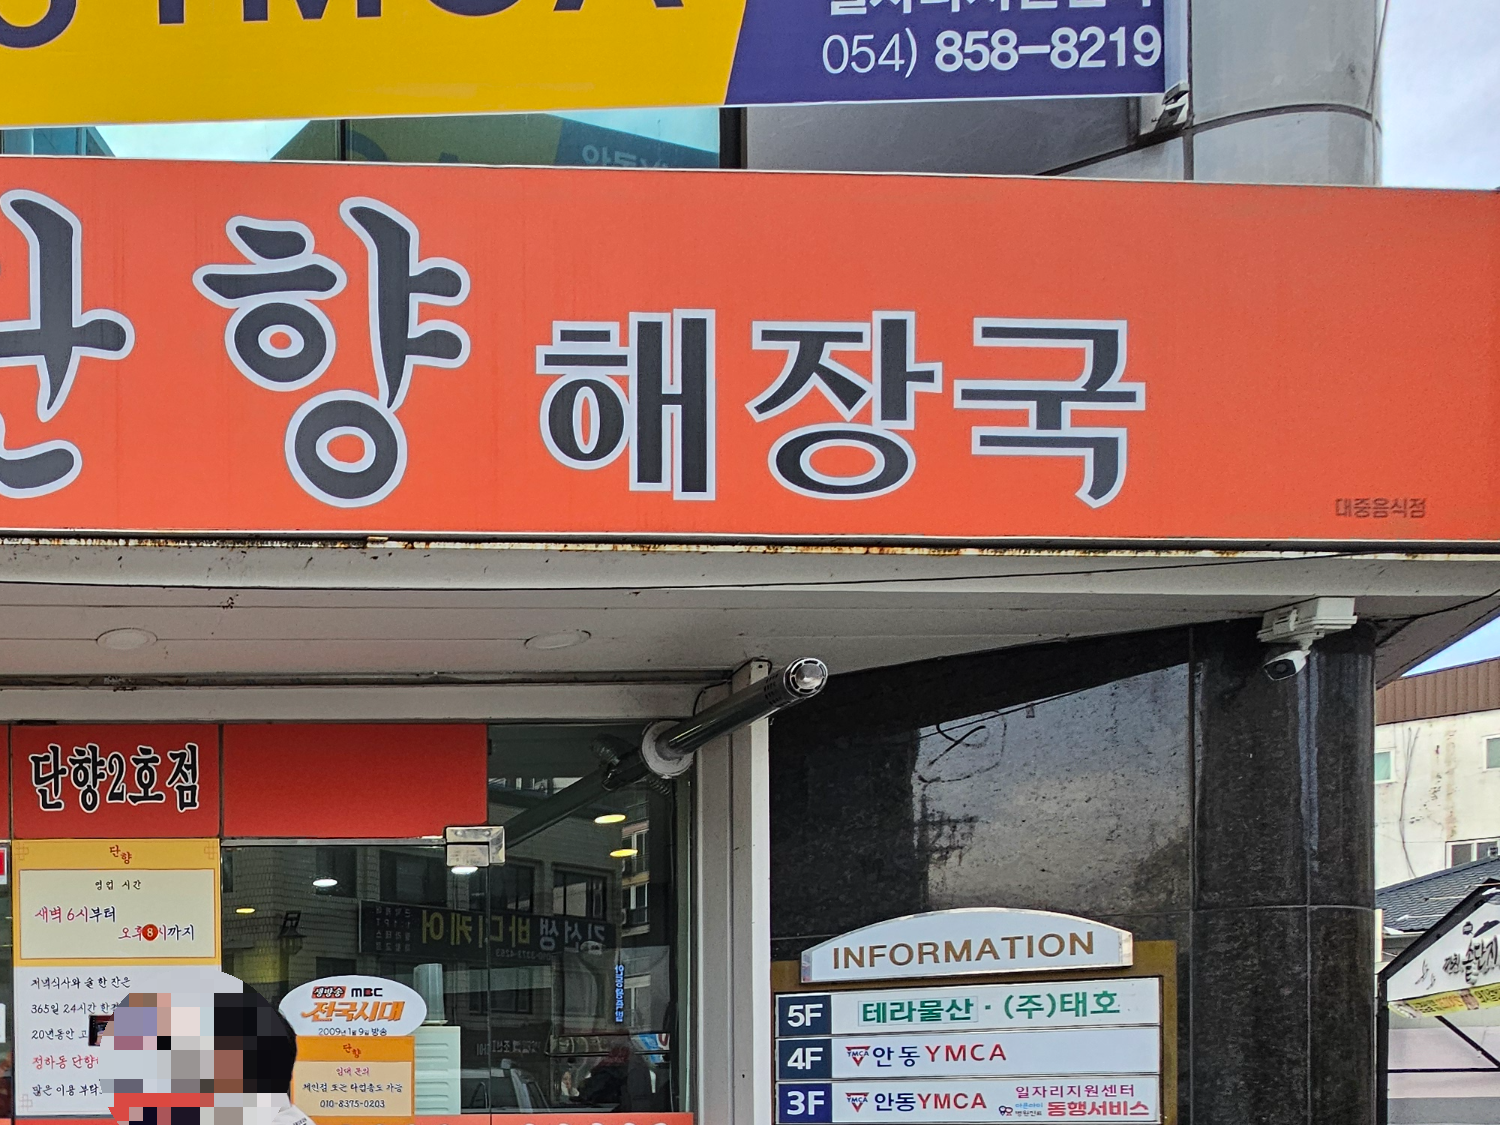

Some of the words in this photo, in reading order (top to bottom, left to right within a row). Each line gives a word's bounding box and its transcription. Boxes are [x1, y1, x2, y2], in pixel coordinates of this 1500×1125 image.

[822, 26, 919, 78] 054)
[934, 24, 1163, 73] 858-8219
[535, 308, 1147, 510] 해장국
[1334, 497, 1428, 519] 대중음식점
[27, 741, 200, 813] 단향2호점
[109, 845, 132, 864] 단향
[94, 879, 115, 891] 영업
[121, 879, 141, 891] 시간
[34, 906, 62, 923] 새벽
[66, 906, 116, 923] 6시부터
[832, 931, 1094, 970] INFORMATION
[30, 977, 81, 990] 저녁식사와
[84, 977, 95, 989] 술
[97, 977, 107, 989] 한
[111, 977, 131, 989] 잔은
[312, 986, 345, 998] 생방송
[351, 987, 383, 997] MBC
[30, 1002, 60, 1015] 365일
[62, 1002, 97, 1015] 24시간
[301, 1001, 405, 1022] 전국시대
[787, 1003, 824, 1028] 5F
[861, 998, 974, 1024] 테라물산
[1003, 990, 1121, 1019] (주)태호
[31, 1028, 75, 1041] 20년동안
[318, 1027, 347, 1036] 2009년
[371, 1027, 388, 1036] 방송
[32, 1055, 67, 1070] 정하동
[72, 1055, 99, 1070] 단향
[787, 1047, 824, 1070] 4F
[56, 1083, 75, 1097] 이용
[79, 1083, 103, 1097] 부탁
[1015, 1084, 1135, 1098] 일자리지원센터
[319, 1099, 386, 1109] 010-8375-0203
[786, 1091, 825, 1115] 3F
[1047, 1100, 1150, 1117] 동행서비스
